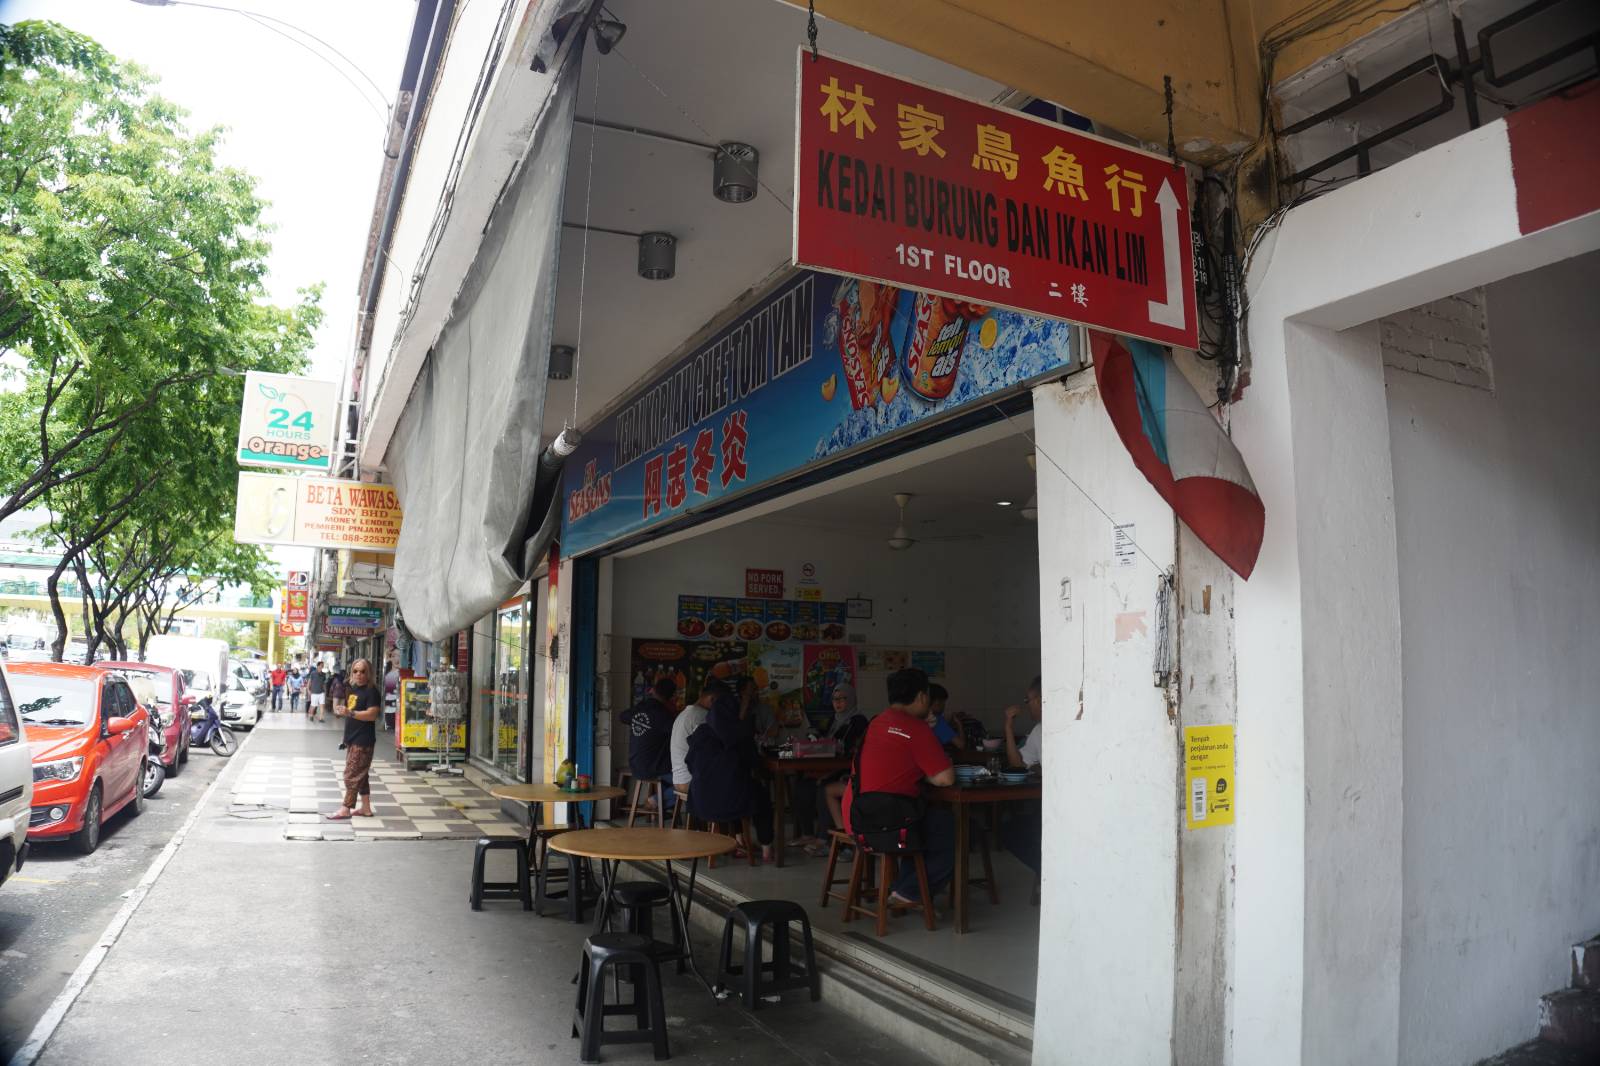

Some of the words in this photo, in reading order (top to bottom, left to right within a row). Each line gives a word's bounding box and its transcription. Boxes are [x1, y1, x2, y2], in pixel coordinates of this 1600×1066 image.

[819, 76, 1147, 218] 林家鳥魚行
[817, 149, 895, 223] KEDAI
[903, 171, 999, 248] BURUNG
[1007, 198, 1050, 260] DAN
[1056, 213, 1110, 275] IKAN
[1114, 228, 1148, 286] LIM
[895, 243, 933, 271] 1ST
[945, 252, 1011, 289] FLOOR
[691, 337, 730, 425] CHEE
[730, 306, 770, 404] TOM
[771, 274, 815, 381] YAM
[932, 348, 959, 377] ais
[268, 407, 314, 432] 24
[266, 429, 311, 440] HOURS
[248, 436, 322, 461] Orange
[306, 485, 343, 505] BETA
[325, 516, 357, 524] MONEY
[360, 519, 394, 527] LENDER
[331, 507, 356, 517] SDN
[361, 509, 389, 518] BHD
[348, 524, 383, 534] PINJAM
[288, 573, 307, 586] 4D
[748, 573, 759, 584] NO
[761, 574, 783, 585] PORK
